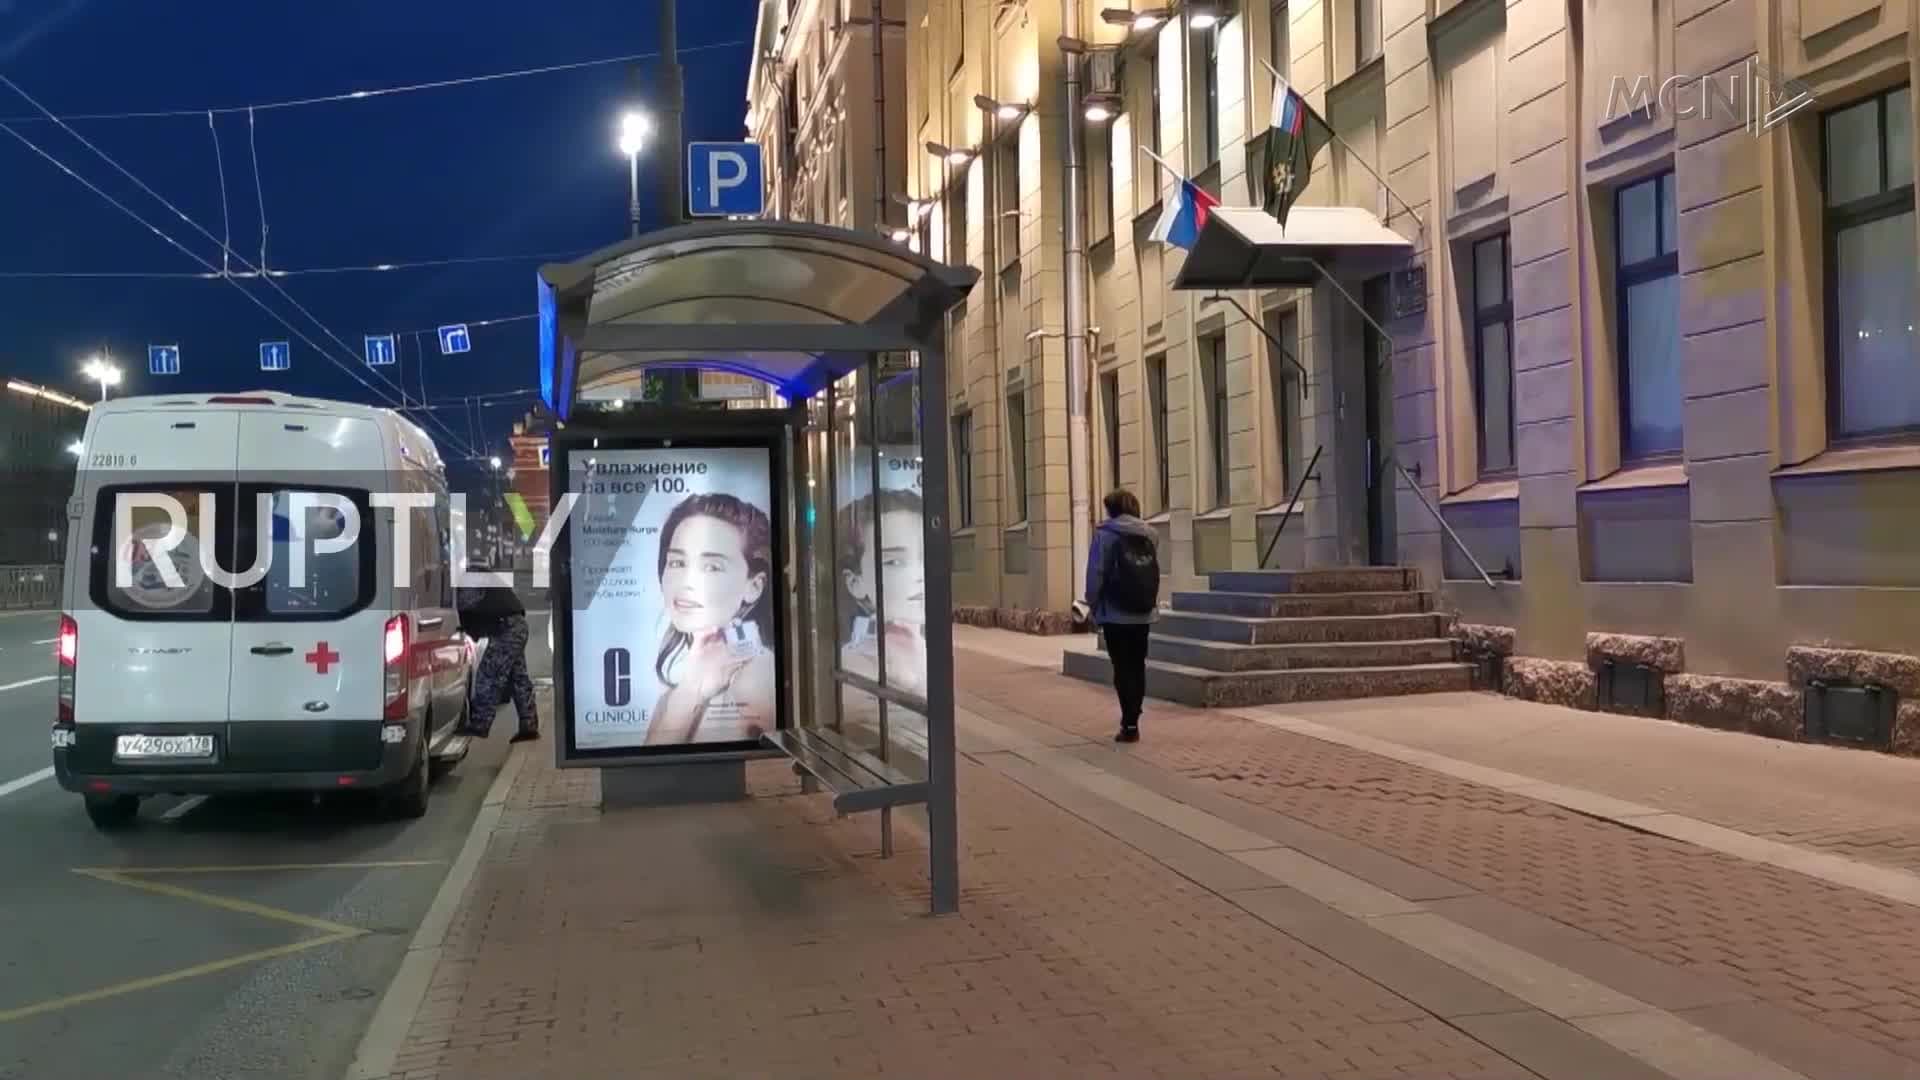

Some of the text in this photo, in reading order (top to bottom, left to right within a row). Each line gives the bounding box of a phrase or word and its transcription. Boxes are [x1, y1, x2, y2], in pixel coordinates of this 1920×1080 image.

[709, 151, 748, 208] P
[582, 458, 708, 476] Увлажнение
[611, 480, 646, 494] все
[654, 478, 691, 493] 100.
[585, 709, 649, 725] CLINIQUE
